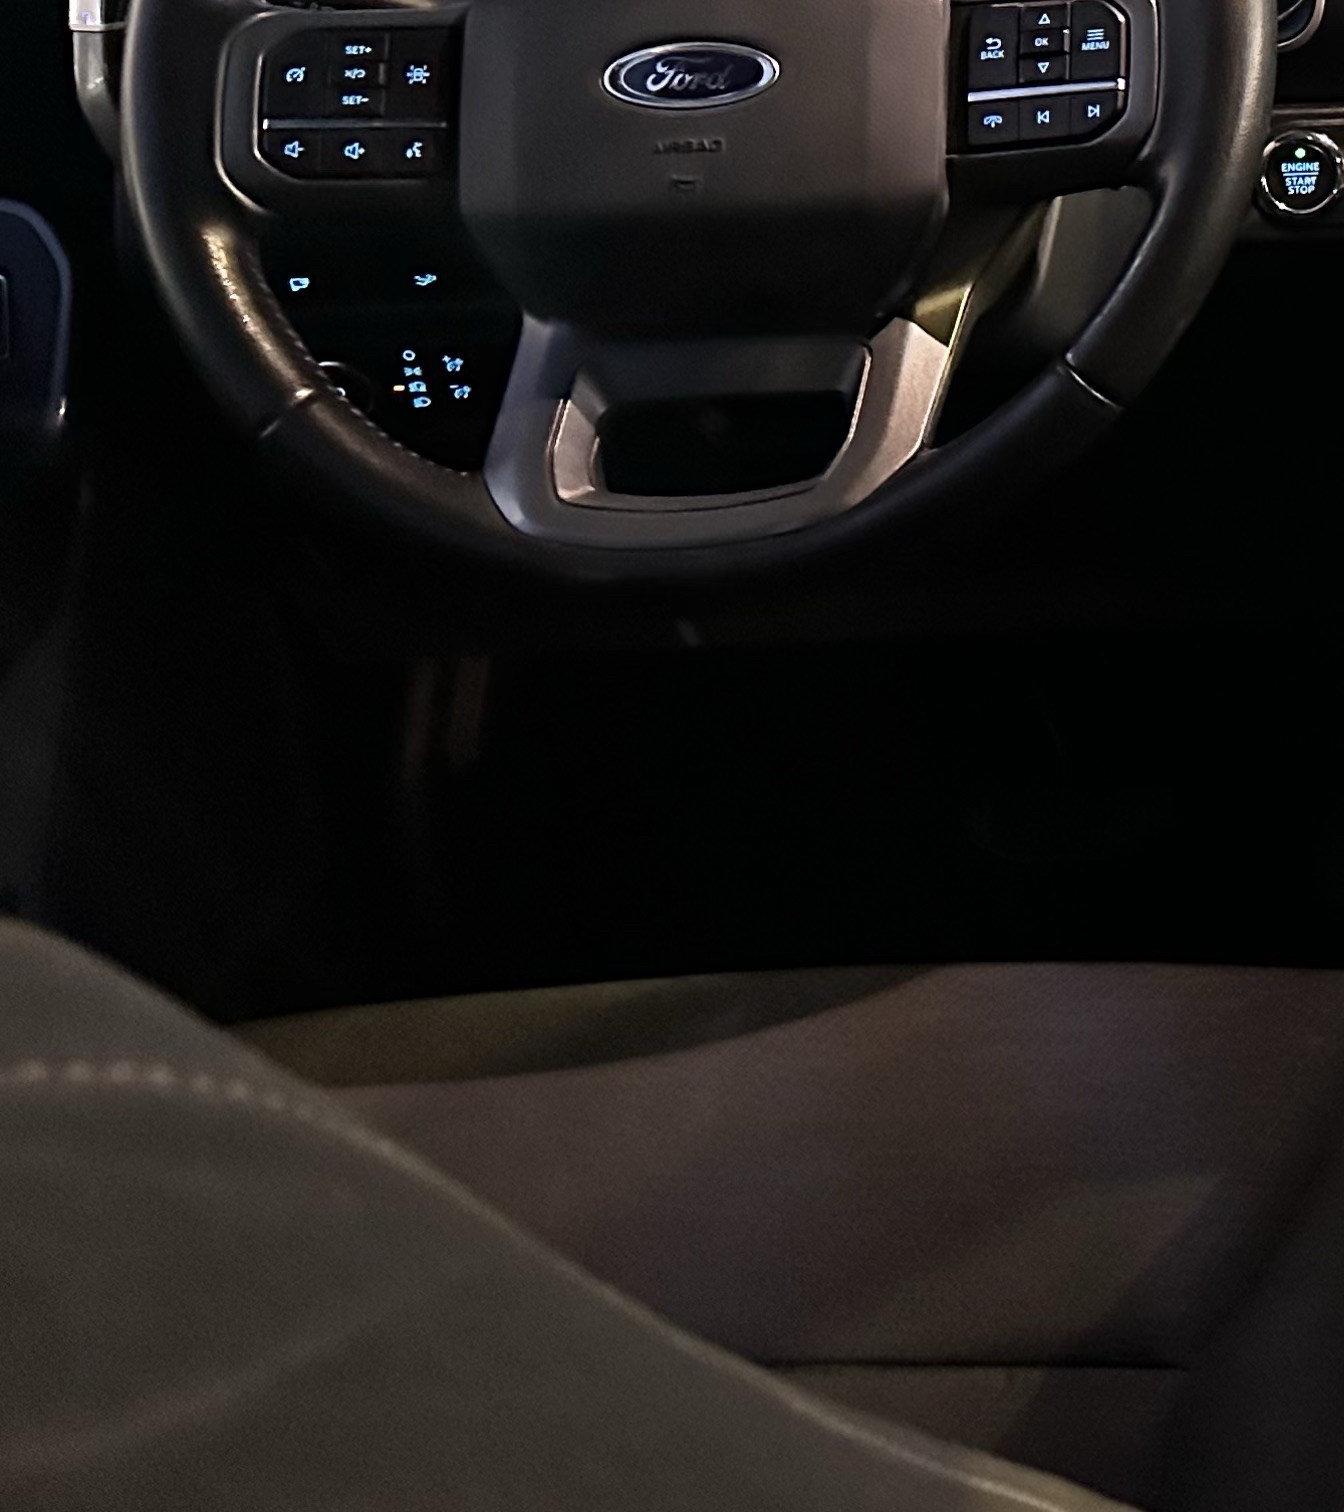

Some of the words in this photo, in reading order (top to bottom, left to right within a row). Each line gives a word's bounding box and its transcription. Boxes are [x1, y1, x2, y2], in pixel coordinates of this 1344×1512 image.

[1034, 37, 1049, 47] OK
[1081, 39, 1110, 52] MENU
[980, 49, 1005, 61] BACK
[646, 56, 734, 92] Ford
[1281, 161, 1320, 173] ENGINE
[1284, 176, 1318, 187] START
[1287, 185, 1316, 196] STOP
